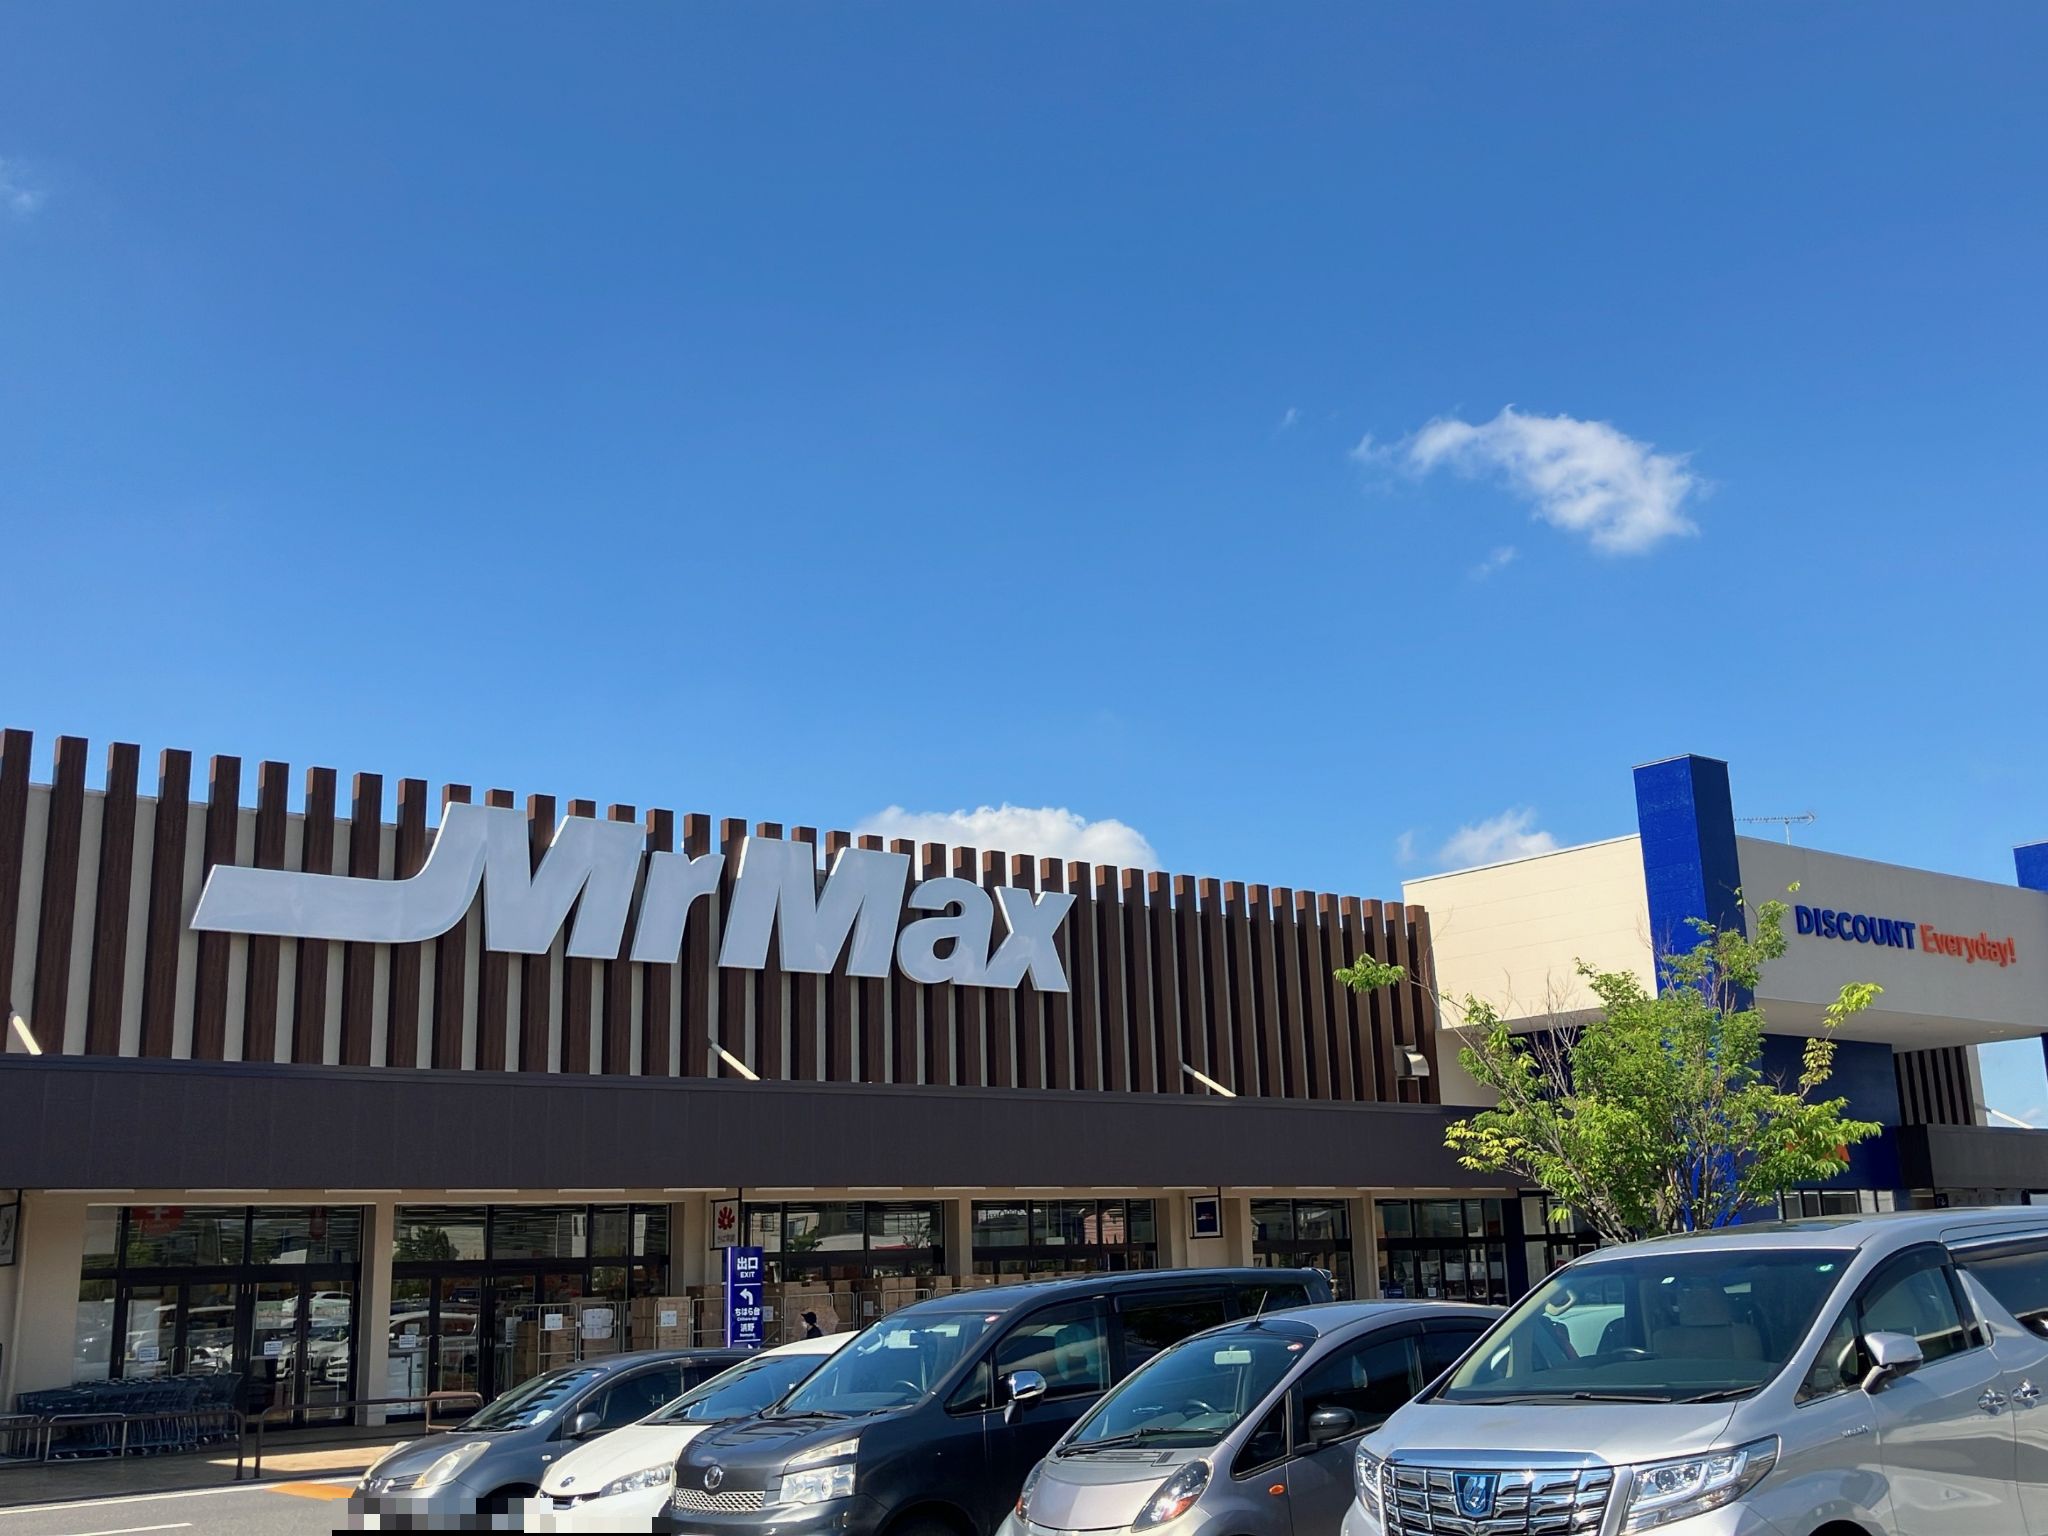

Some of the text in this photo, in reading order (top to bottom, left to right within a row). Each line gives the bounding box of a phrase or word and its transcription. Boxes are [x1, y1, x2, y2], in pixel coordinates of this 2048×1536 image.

[189, 801, 1076, 993] MrMax
[1795, 905, 2017, 968] DISCOUNT Everyday!
[737, 1256, 759, 1271] 出口
[740, 1271, 756, 1279] EXIT
